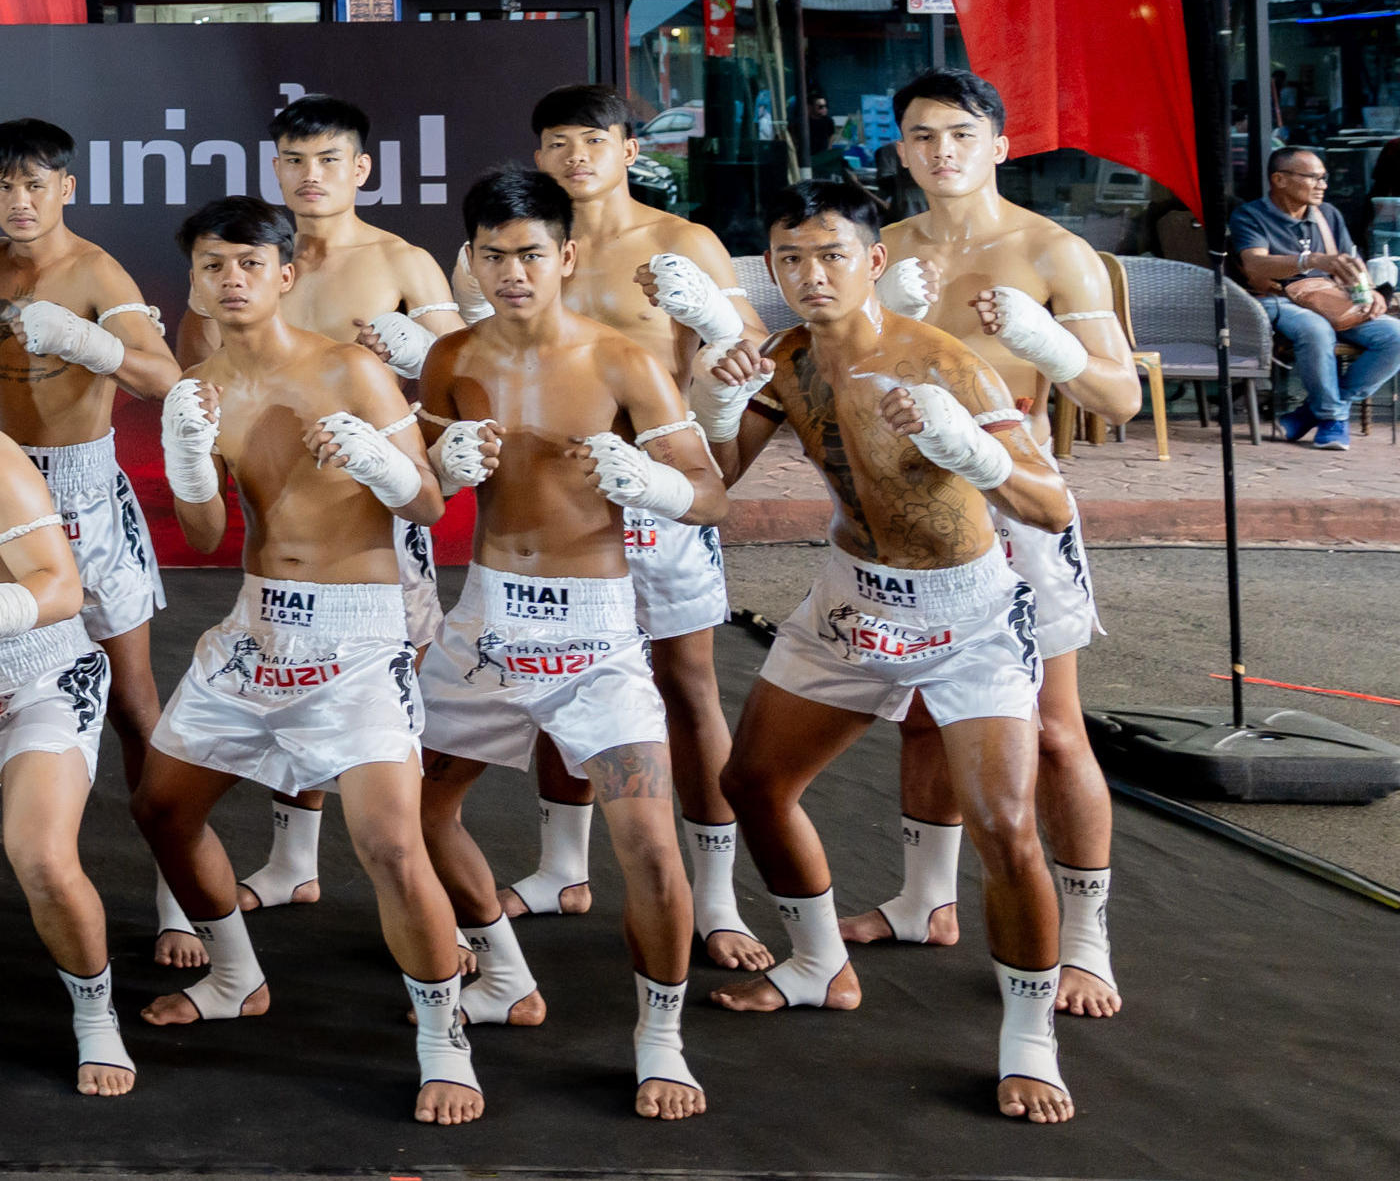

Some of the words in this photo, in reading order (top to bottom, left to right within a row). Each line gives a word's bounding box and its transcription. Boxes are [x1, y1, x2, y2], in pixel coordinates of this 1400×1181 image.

[852, 565, 915, 594] THAI
[261, 587, 315, 611] THAI
[503, 582, 568, 605] THAI
[261, 607, 313, 622] FIGHT
[506, 602, 568, 616] FIGHT
[504, 642, 610, 654] THAILAND
[851, 628, 952, 656] ISUZU
